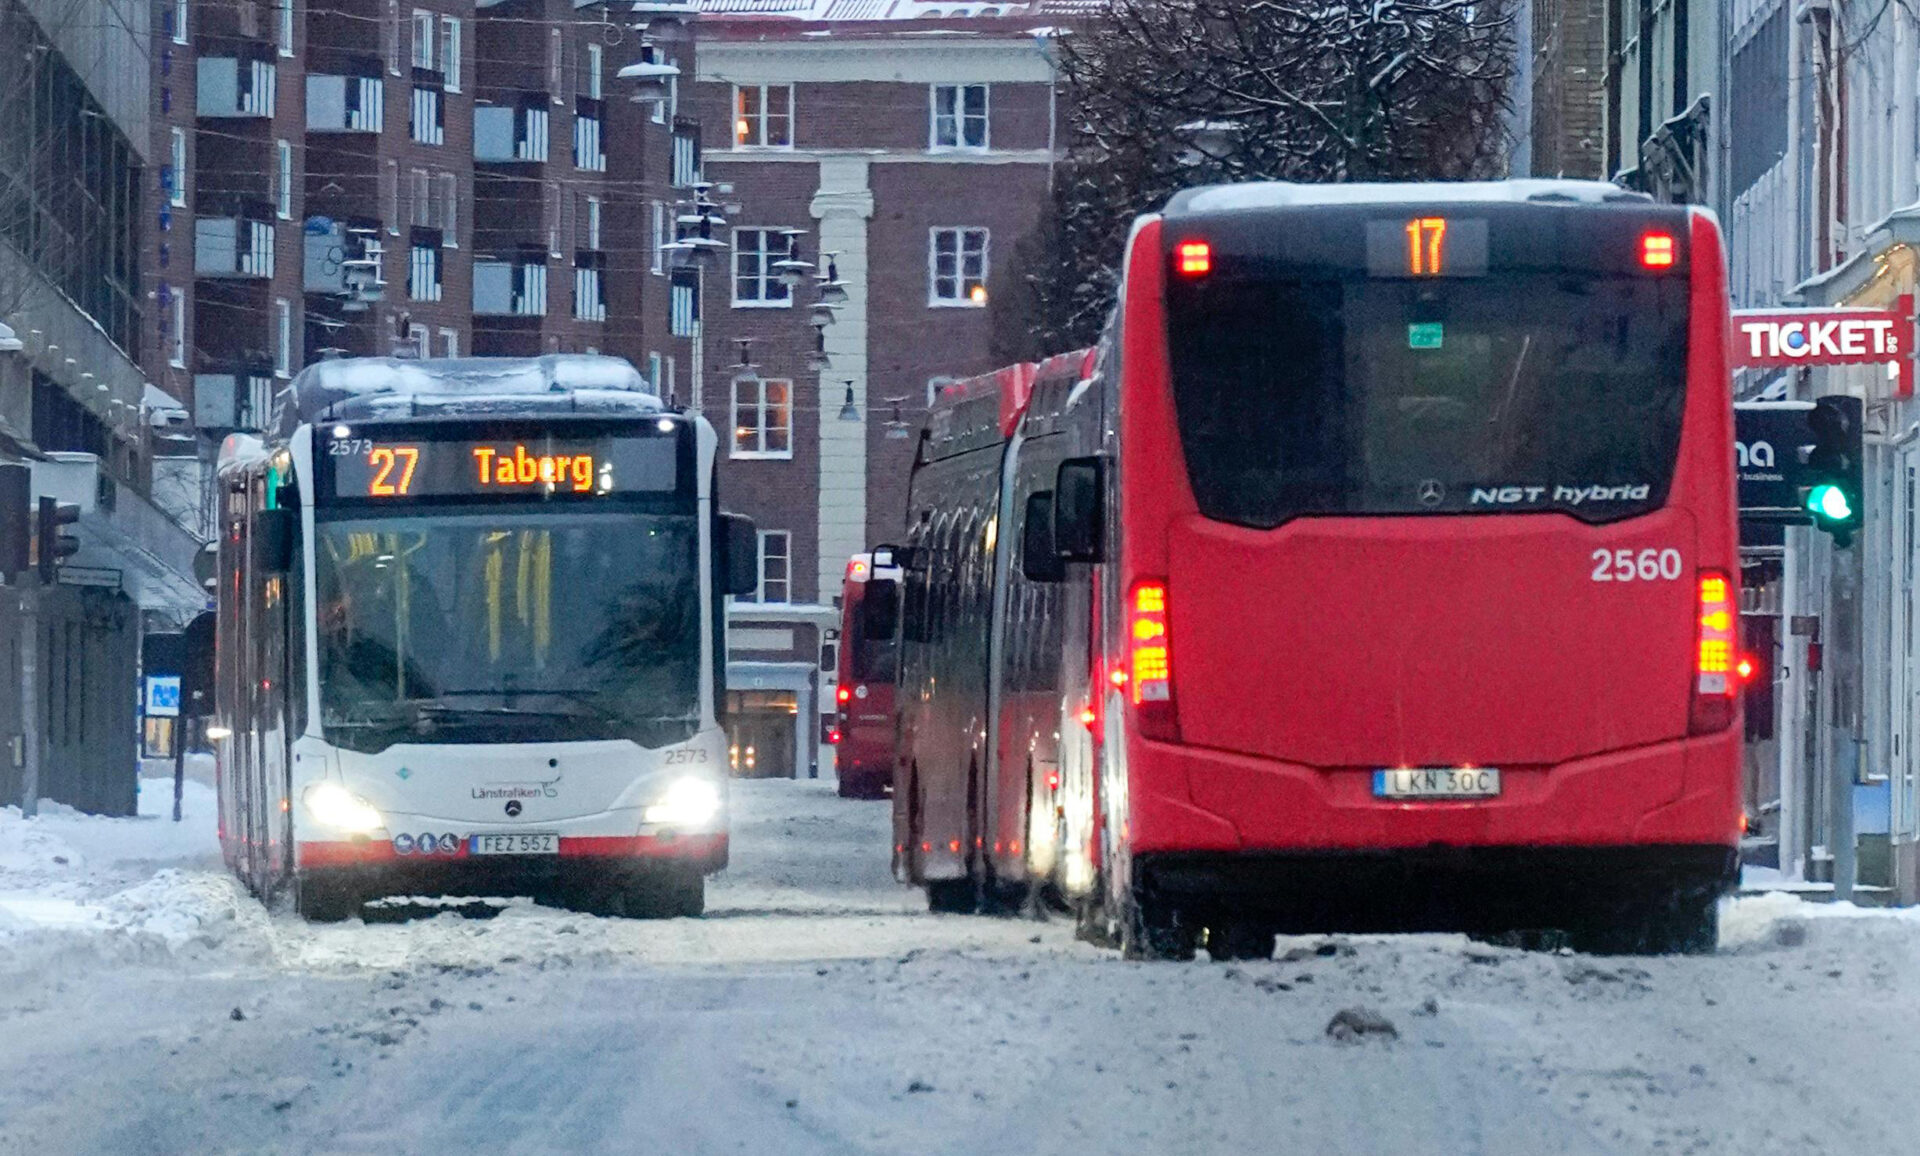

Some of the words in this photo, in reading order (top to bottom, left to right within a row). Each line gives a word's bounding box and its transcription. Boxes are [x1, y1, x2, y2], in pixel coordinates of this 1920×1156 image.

[1406, 217, 1446, 274] 17
[1741, 319, 1893, 358] TICKET
[329, 438, 373, 456] 2573
[368, 447, 419, 496] 27
[473, 443, 594, 491] Taberg
[1471, 486, 1545, 504] NGT
[1553, 483, 1650, 505] hybrid
[1591, 547, 1682, 582] 2560
[664, 748, 708, 765] 2573
[1394, 770, 1437, 792] LKN
[471, 787, 542, 800] Länstrafiken
[483, 836, 515, 851] FEZ
